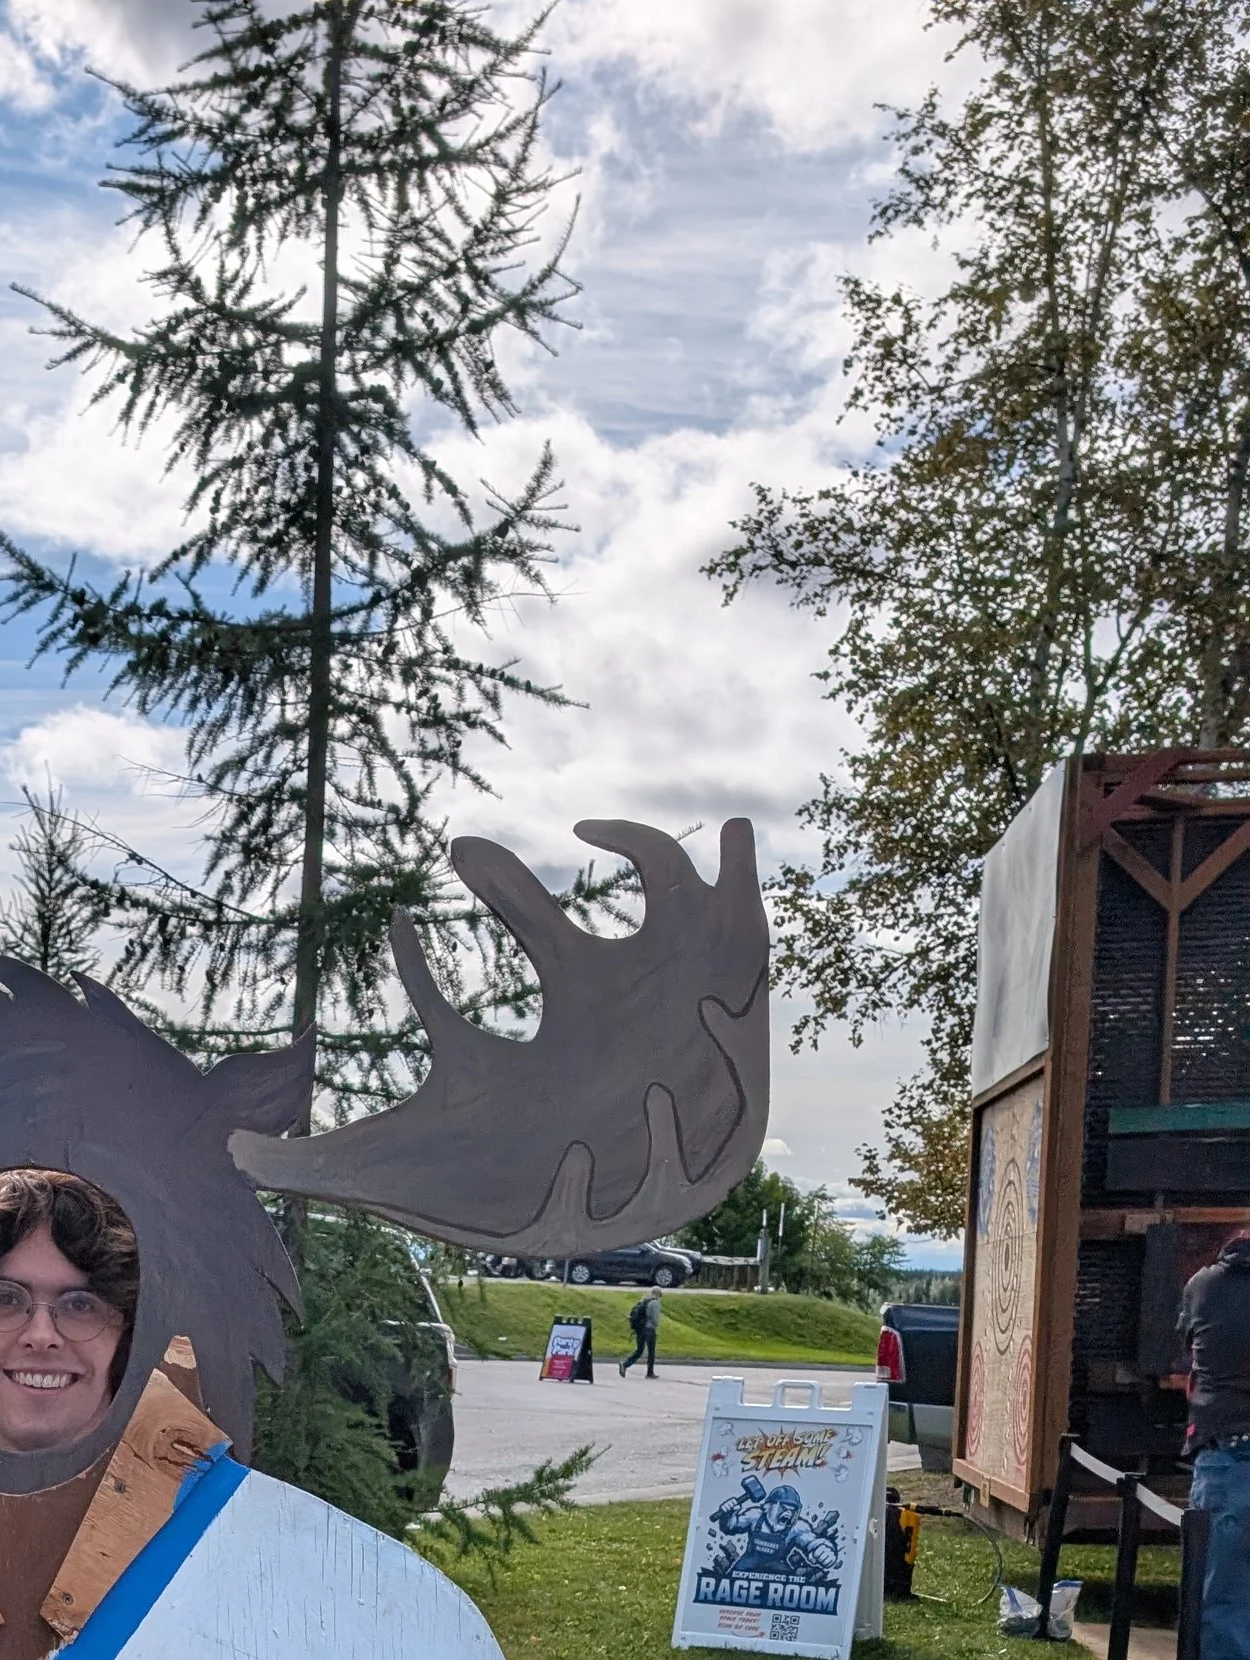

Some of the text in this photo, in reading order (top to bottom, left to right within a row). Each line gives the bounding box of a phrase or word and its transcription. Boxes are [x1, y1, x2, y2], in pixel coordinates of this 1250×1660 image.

[793, 1428, 833, 1447] SOME
[741, 1443, 832, 1472] STEAM!
[732, 1570, 806, 1583] EXPERIENCE THE
[699, 1576, 838, 1612] RAGE ROOM
